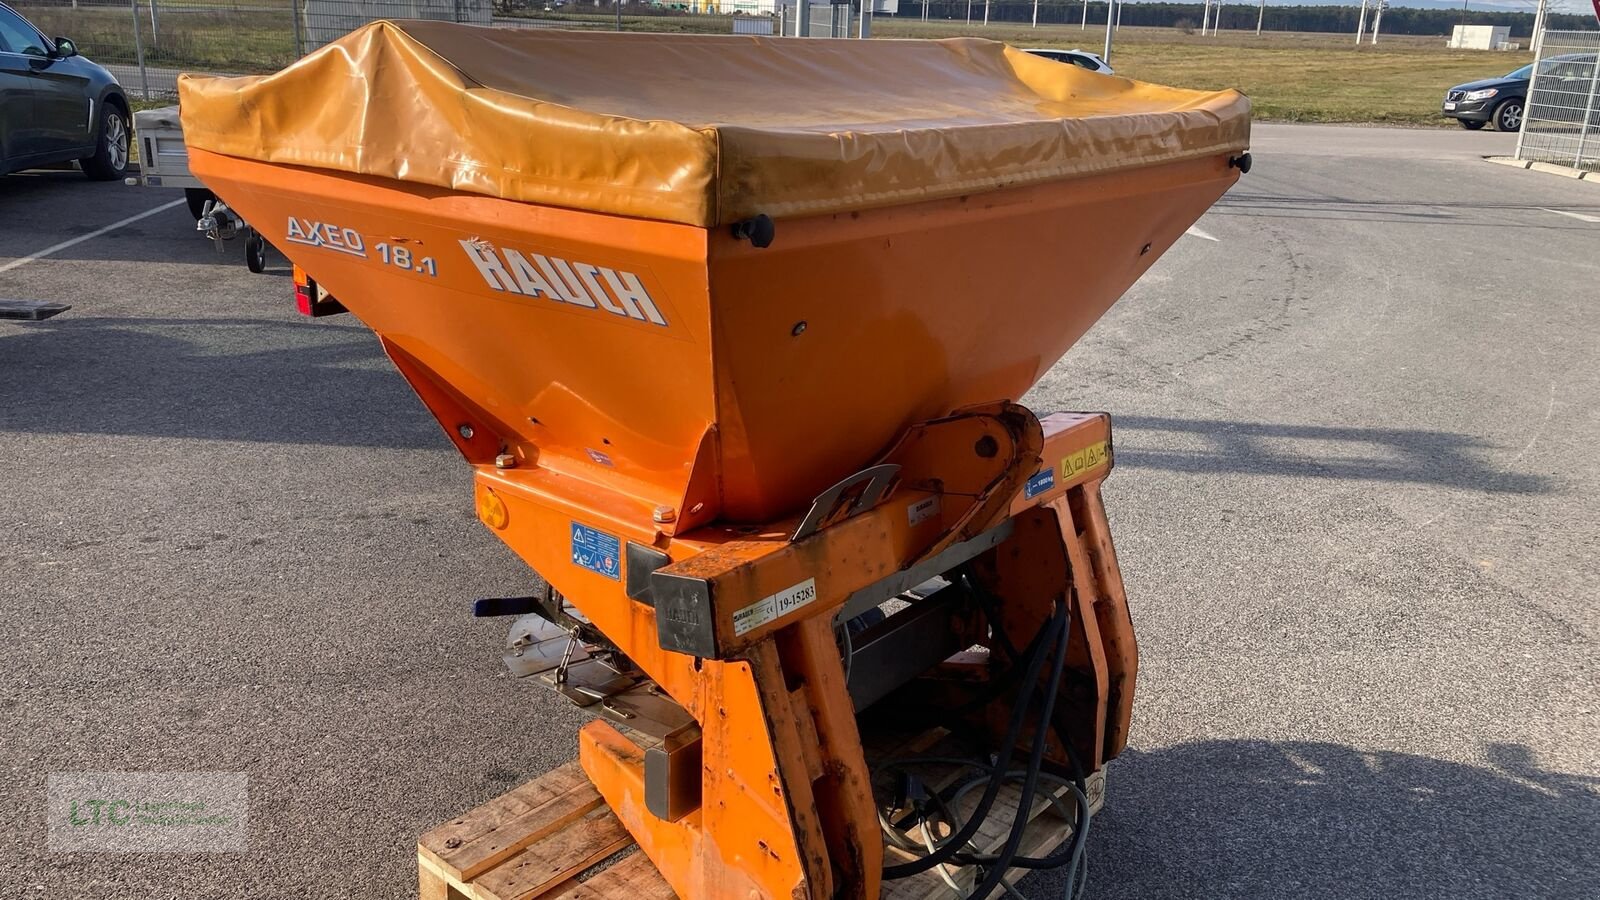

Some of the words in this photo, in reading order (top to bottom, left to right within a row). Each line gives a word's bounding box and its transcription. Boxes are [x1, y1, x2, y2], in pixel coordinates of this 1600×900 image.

[286, 216, 367, 256] AXEO
[375, 242, 437, 277] 18.1
[458, 238, 668, 327] RAUCH
[779, 586, 815, 611] 19-15283
